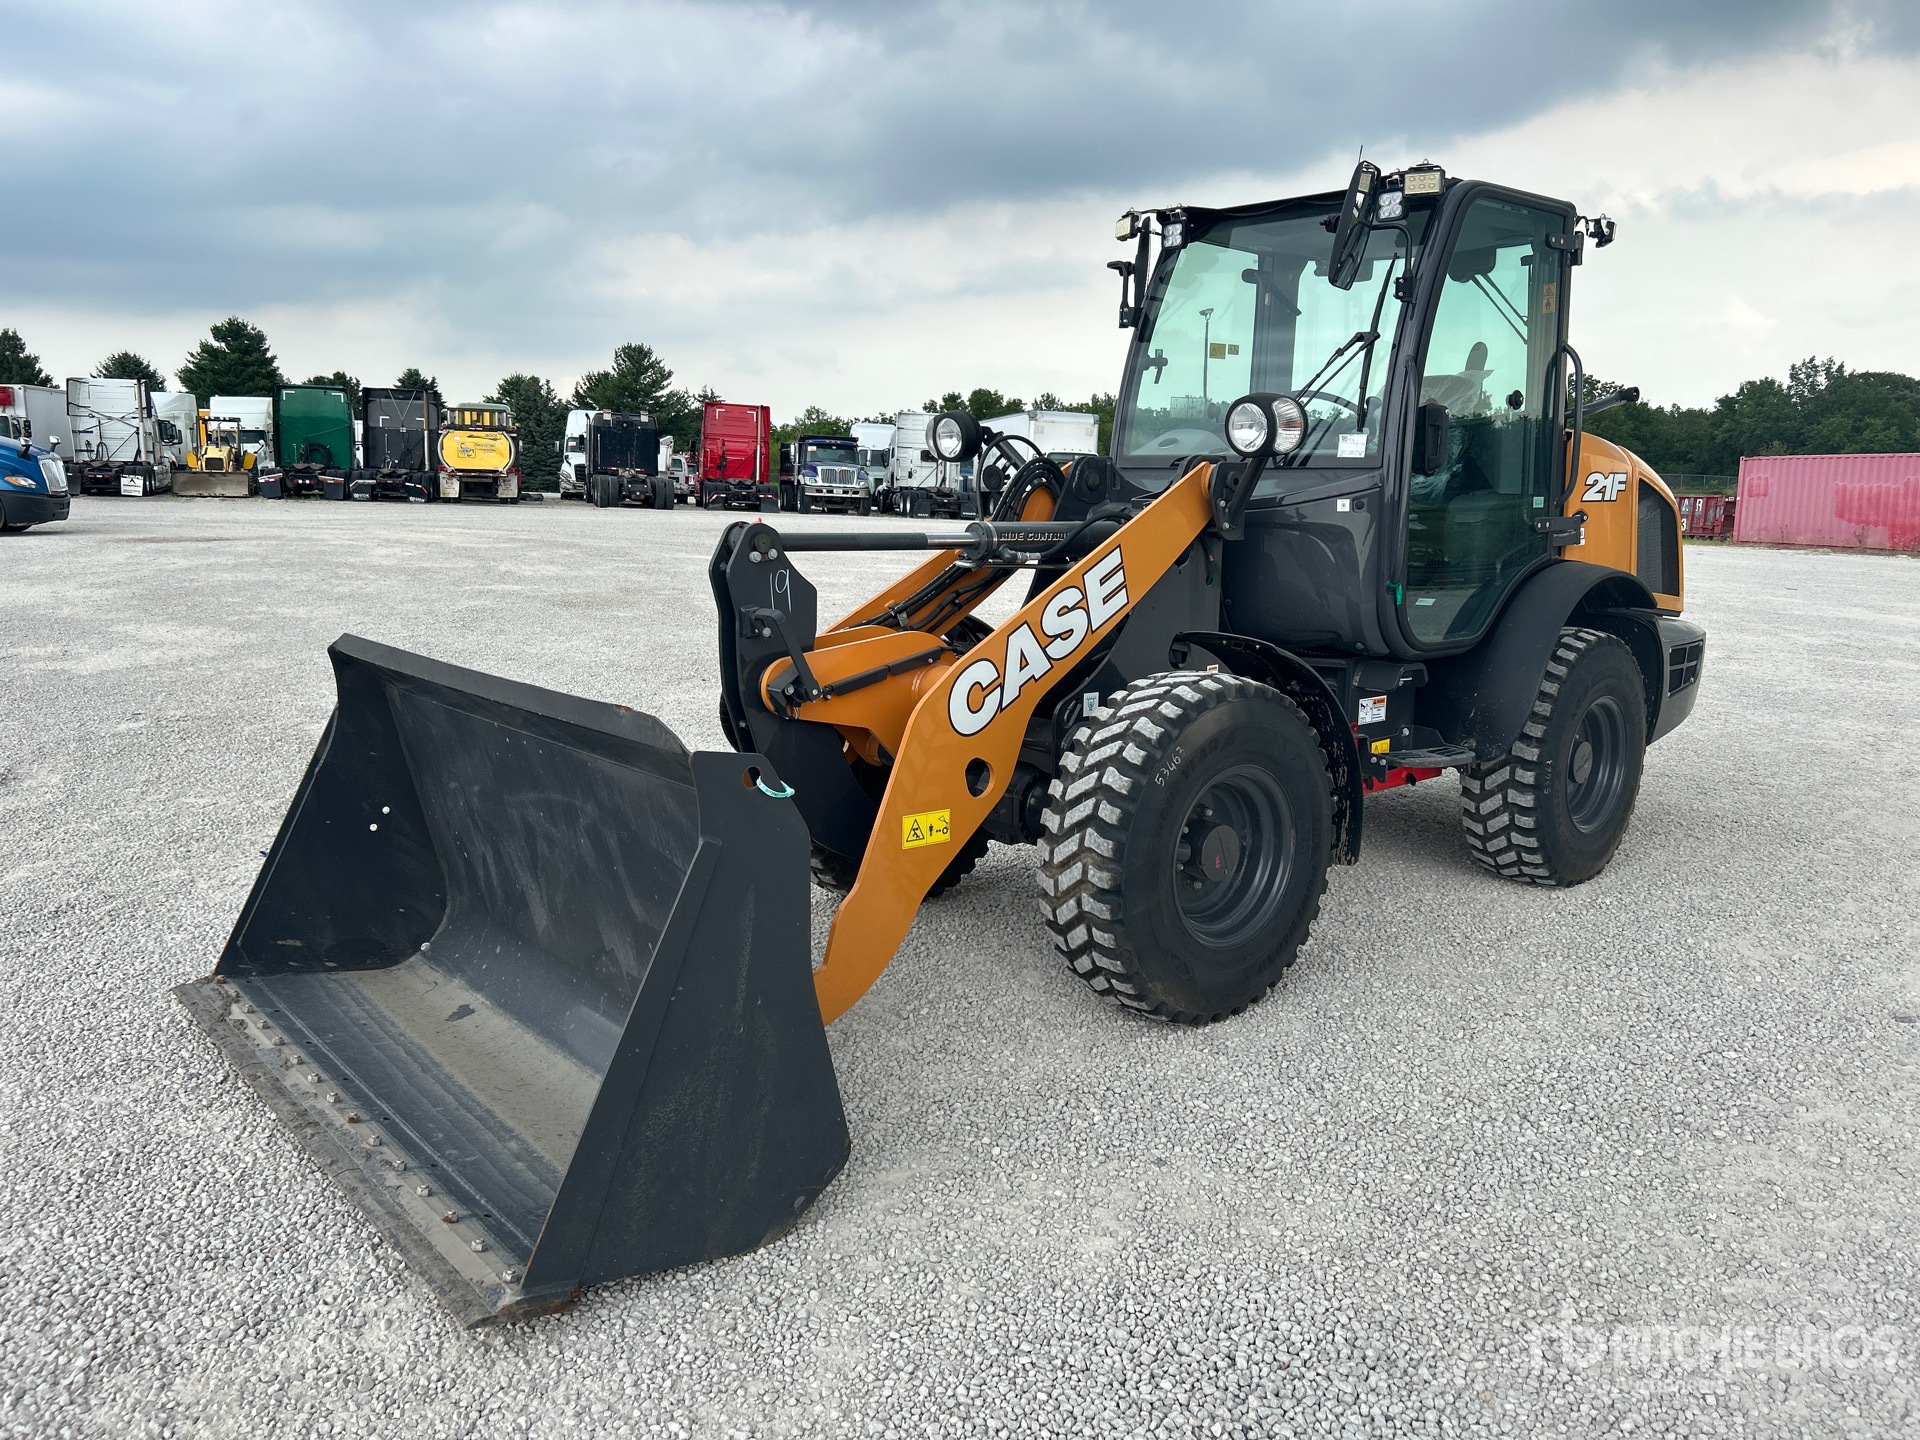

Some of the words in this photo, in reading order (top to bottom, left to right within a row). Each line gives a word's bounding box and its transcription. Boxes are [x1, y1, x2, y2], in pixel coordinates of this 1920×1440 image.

[1581, 471, 1628, 502] 21F
[1000, 532, 1025, 541] RIDE
[1027, 532, 1070, 541] CONTRO
[770, 568, 792, 613] 19
[948, 543, 1130, 738] CASE
